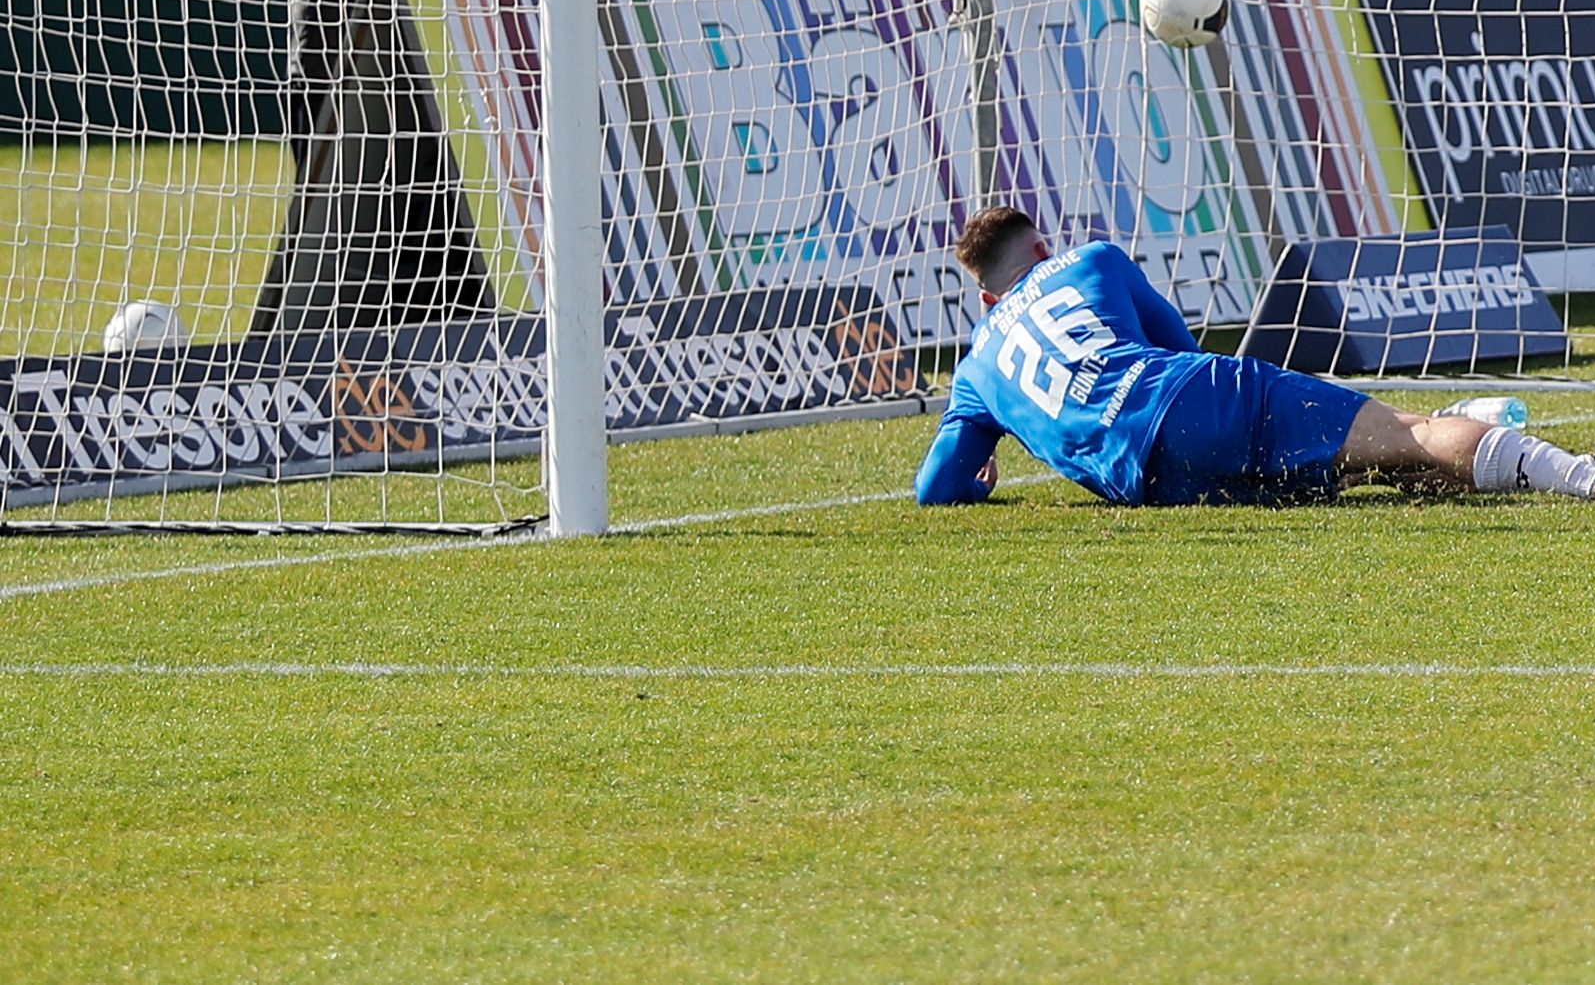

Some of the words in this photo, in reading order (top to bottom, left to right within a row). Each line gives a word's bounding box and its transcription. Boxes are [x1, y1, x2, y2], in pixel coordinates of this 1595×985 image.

[998, 283, 1043, 336] BERLIN
[1336, 265, 1538, 323] SKECHERS
[997, 285, 1117, 421] 26
